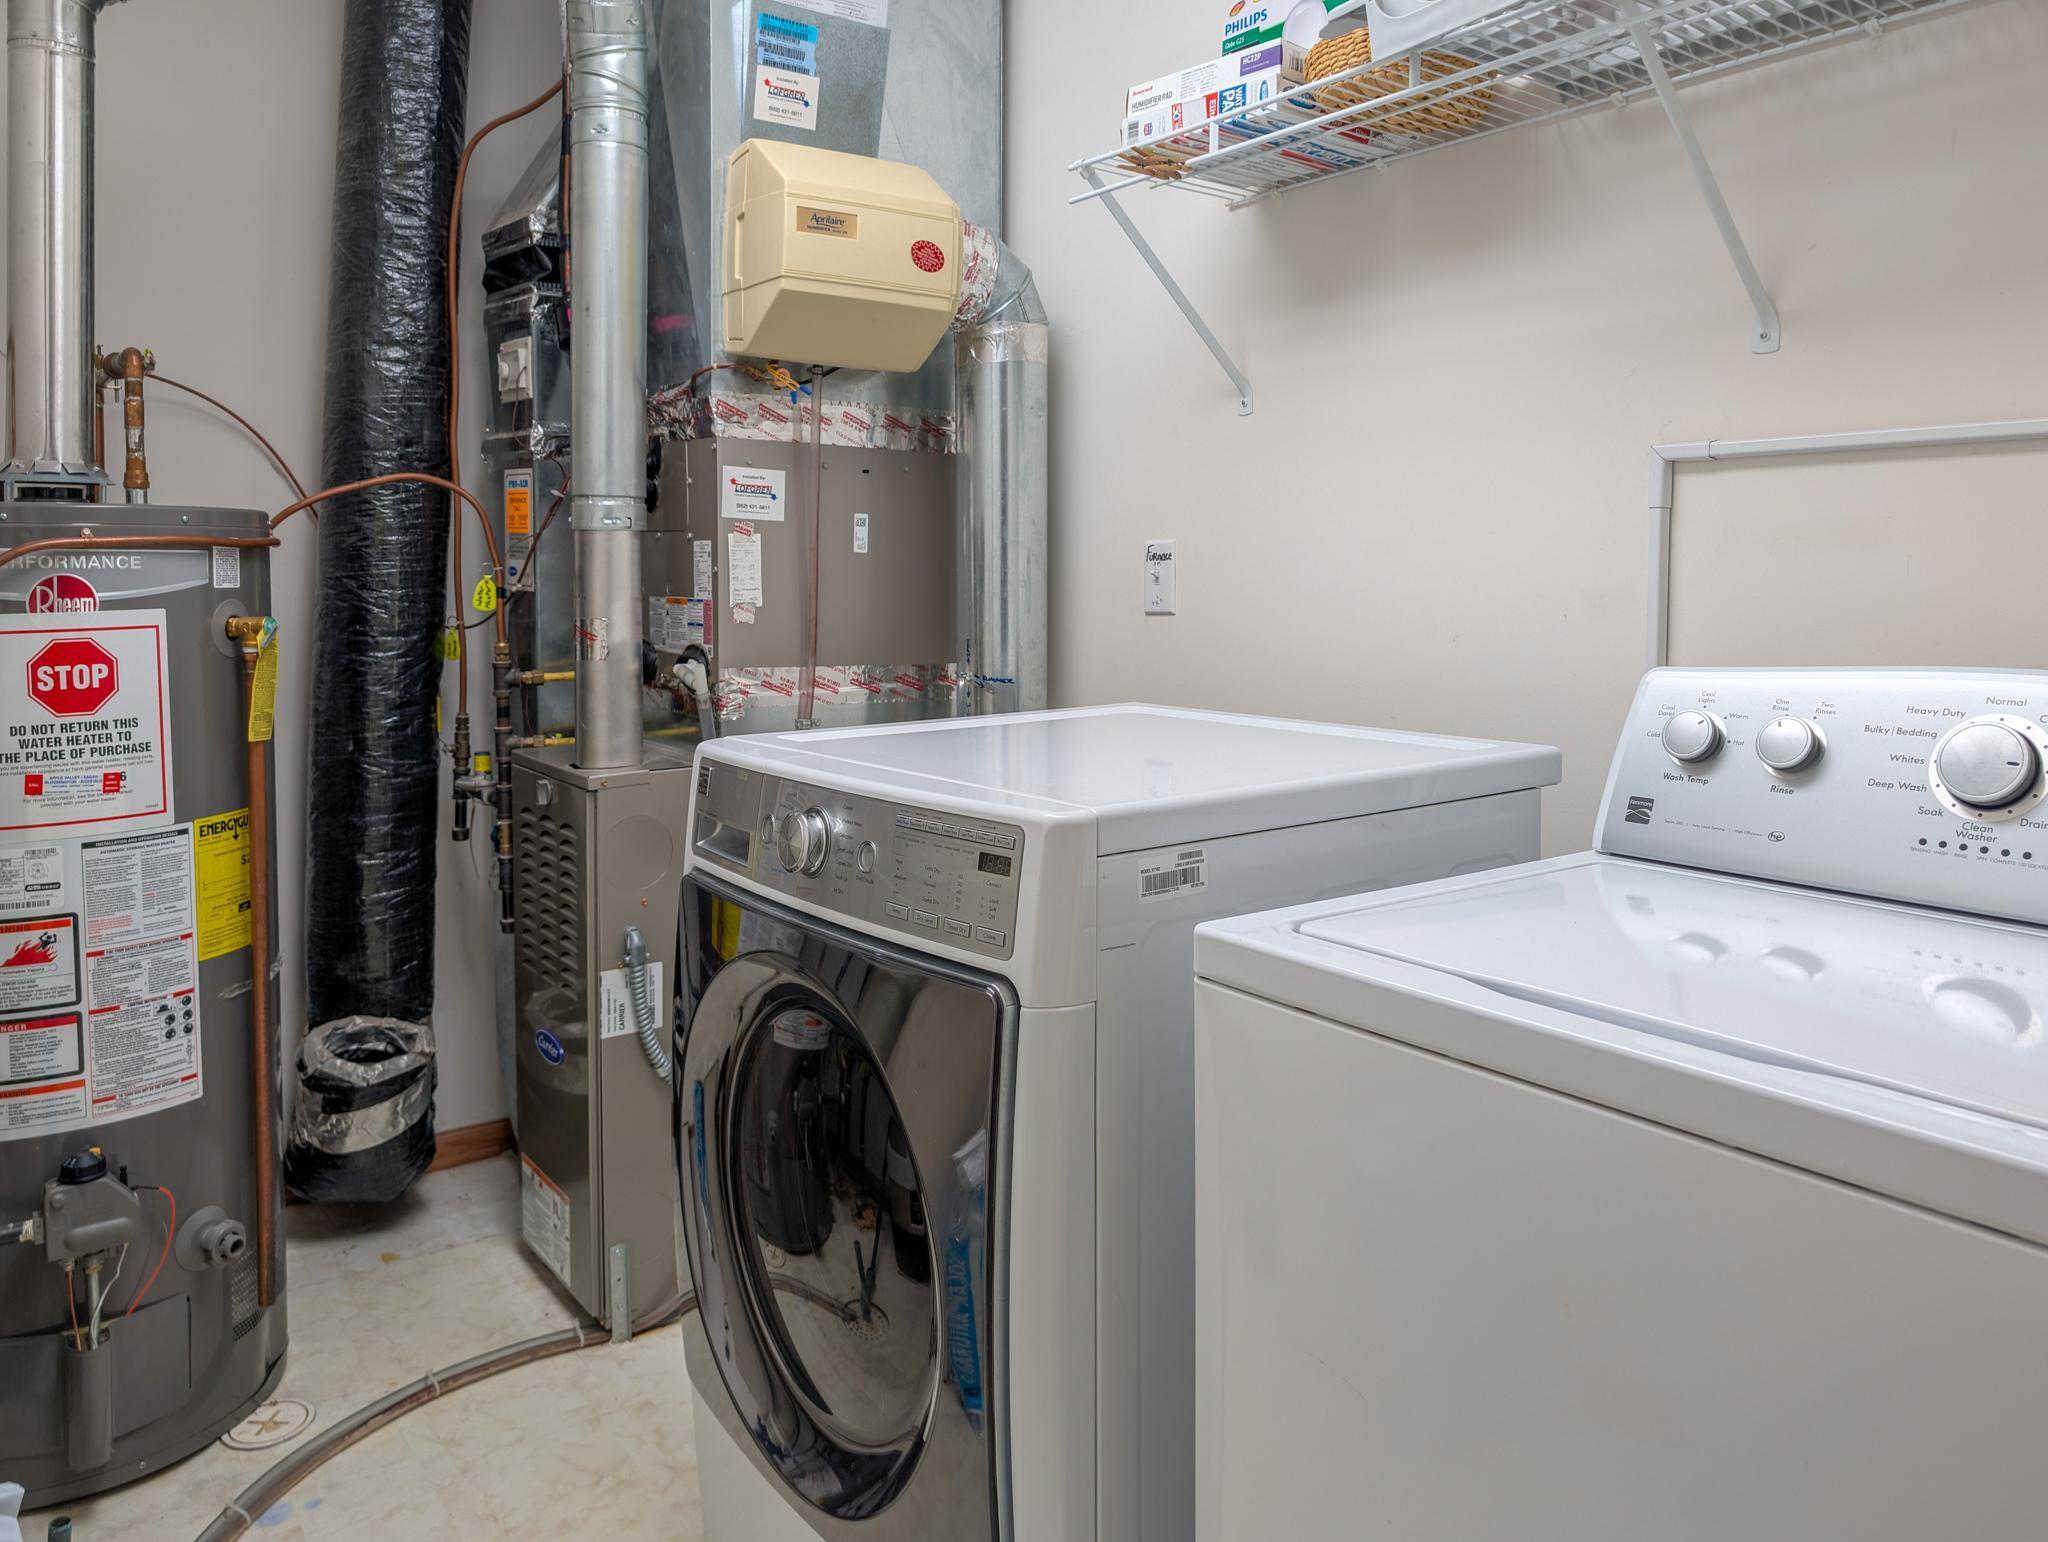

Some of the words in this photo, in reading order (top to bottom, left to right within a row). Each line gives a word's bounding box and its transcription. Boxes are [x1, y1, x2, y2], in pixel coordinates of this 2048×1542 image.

[1225, 8, 1268, 36] PHILIPS
[1243, 53, 1261, 64] HC22P
[768, 86, 806, 100] LOFGREN
[1132, 94, 1162, 111] HUMIDIFIER
[1162, 91, 1173, 102] PAD
[810, 213, 846, 226] Aprilaire
[734, 484, 773, 495] LOFGREN
[36, 576, 94, 614] Rheem
[37, 664, 109, 691] STOP
[1772, 704, 1790, 712] Rinse
[1775, 698, 1790, 706] One
[1986, 697, 2028, 707] Normal
[1815, 707, 1837, 715] Rinses
[1906, 705, 1939, 718] Heavy
[1942, 708, 1967, 720] Duty
[10, 726, 26, 737] DO
[31, 724, 56, 735] NOT
[61, 720, 109, 733] RETURN
[113, 717, 139, 729] THIS
[18, 737, 62, 749] WATER
[67, 733, 113, 746] HEATER
[118, 731, 132, 742] TO
[0, 753, 21, 764] THE
[26, 749, 66, 762] PLACE
[70, 748, 86, 759] OF
[90, 742, 152, 757] PURCHASE
[1890, 754, 1925, 765] Whites
[1663, 772, 1685, 783] Wash
[1687, 775, 1709, 786] Temp
[1867, 778, 1894, 790] Deep
[1898, 781, 1927, 792] Wash
[1770, 785, 1795, 795] Rinse
[1630, 799, 1653, 807] Kenmore
[1917, 806, 1944, 817] Soak
[1961, 821, 1993, 834] Clean
[1955, 829, 1998, 843] Washer
[1989, 857, 2016, 866] COMPLETE
[0, 924, 31, 935] NING
[538, 1034, 559, 1058] Carrier
